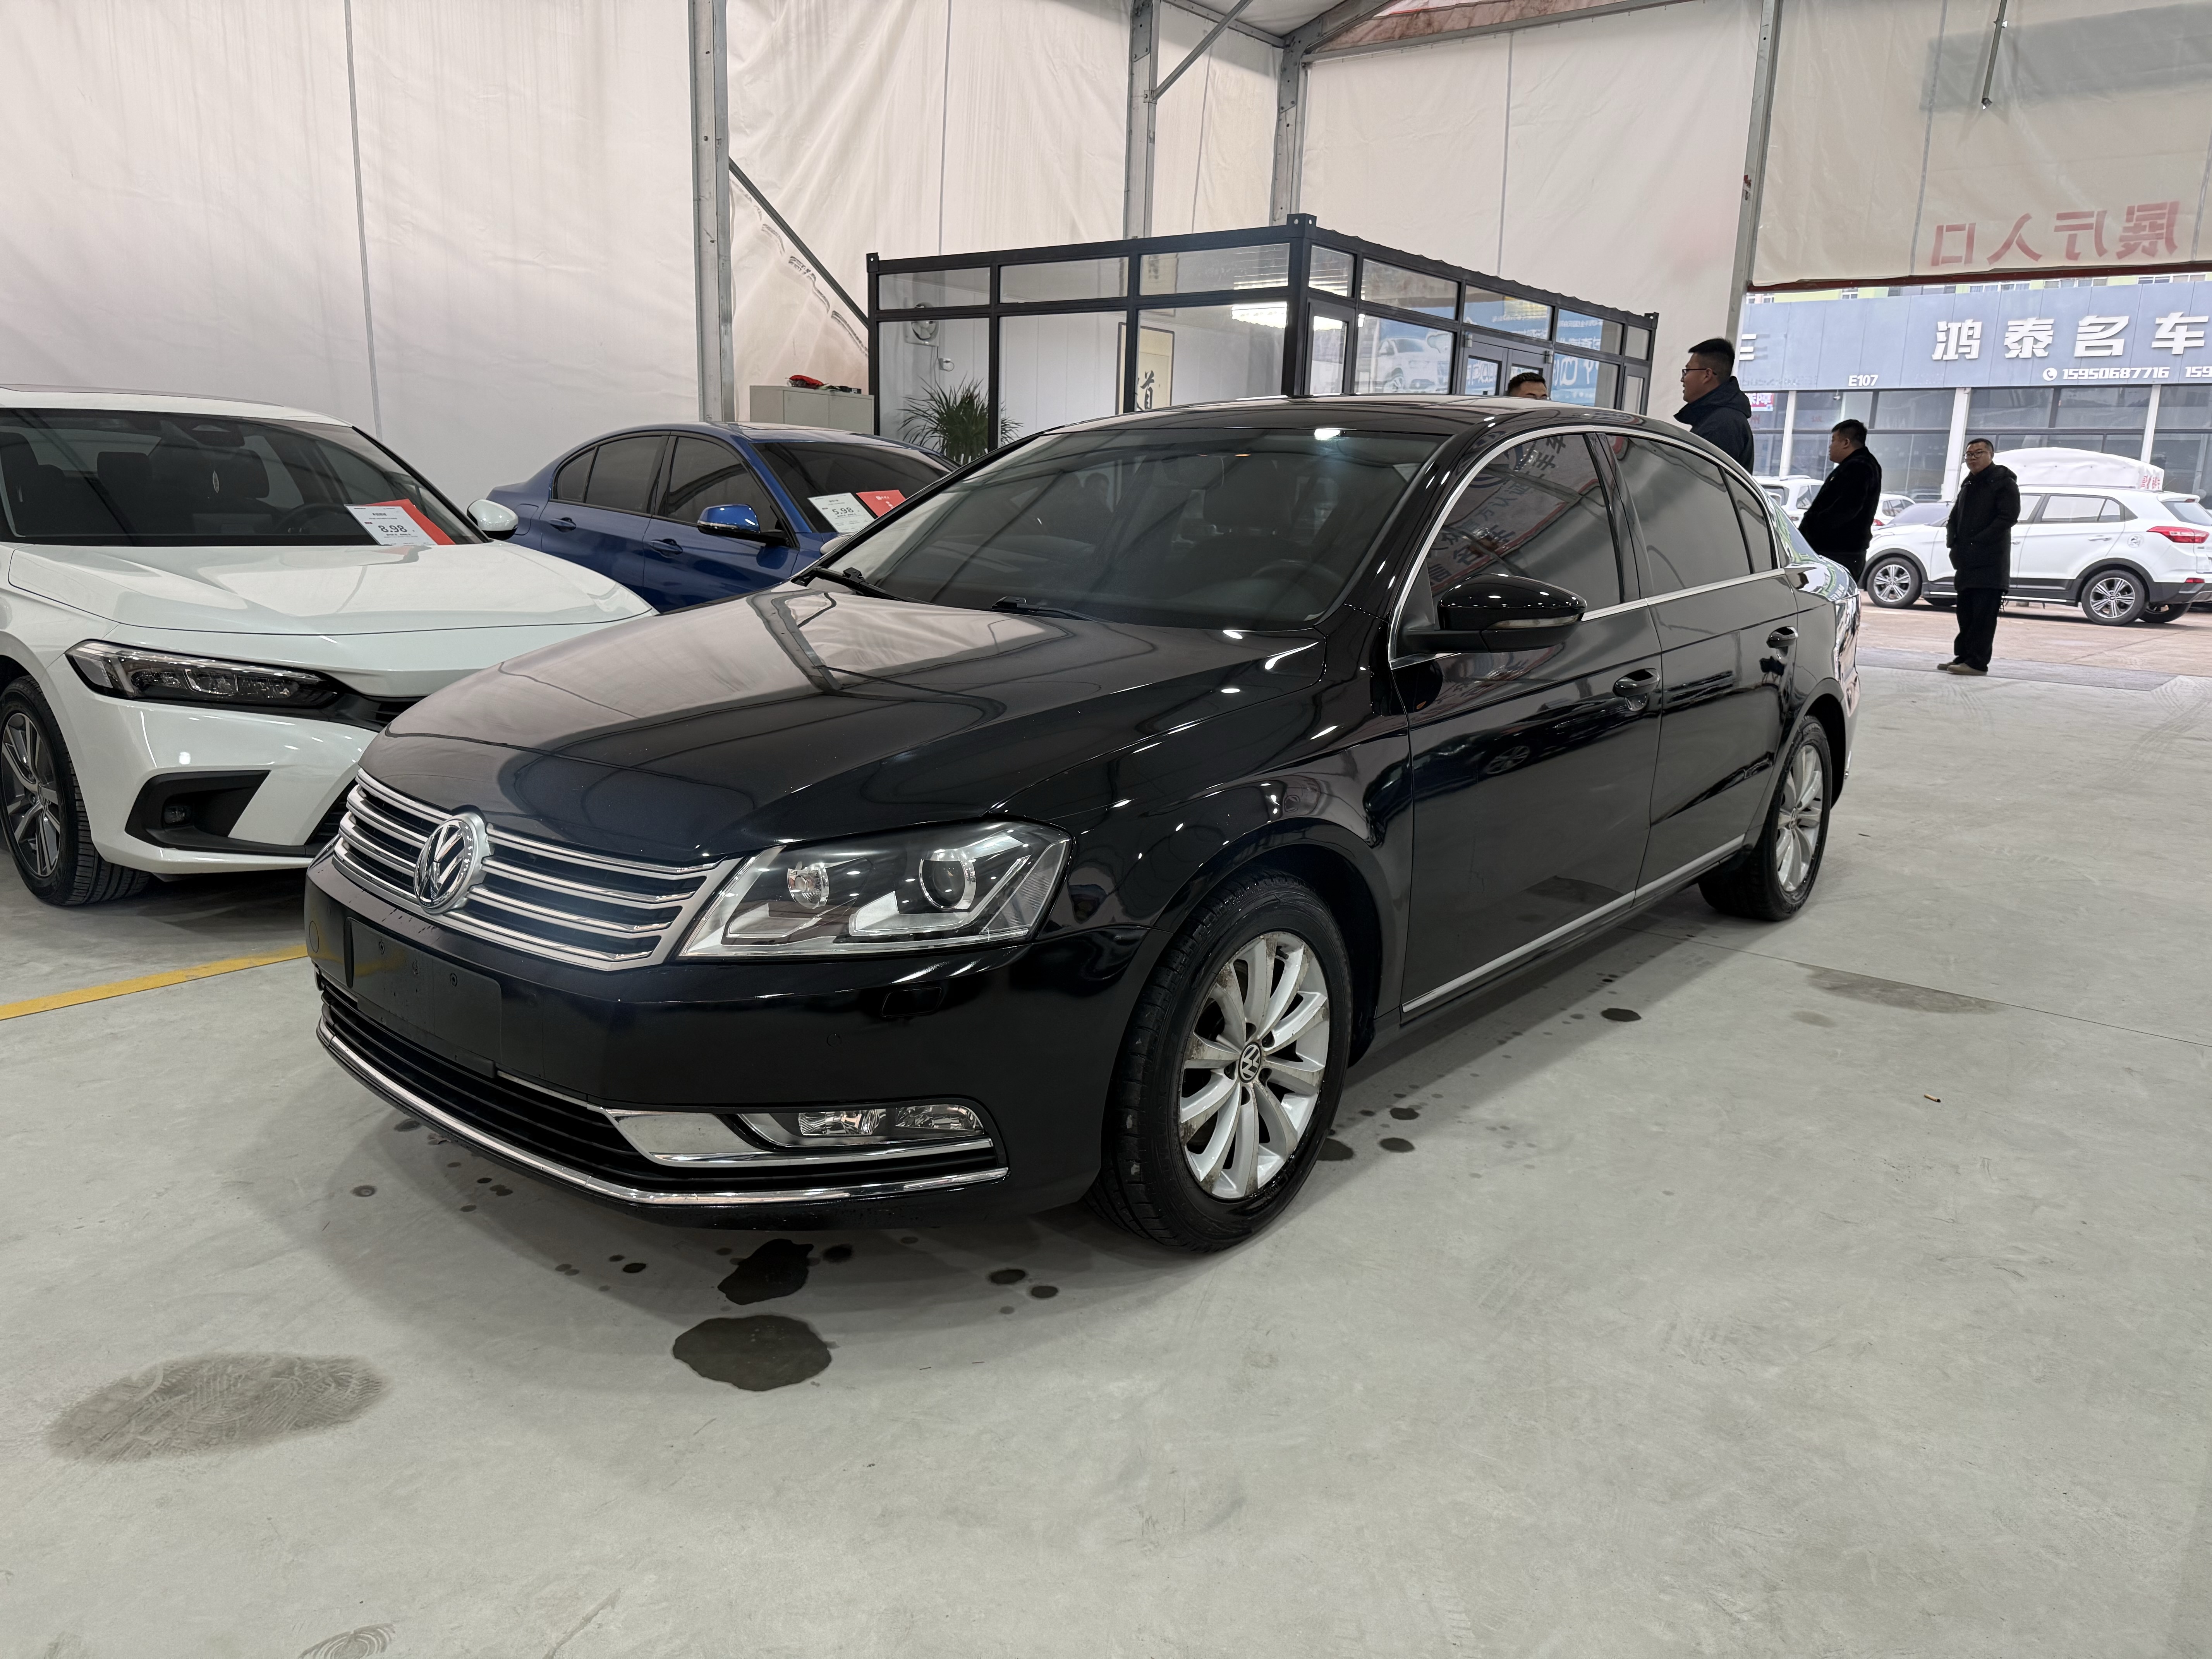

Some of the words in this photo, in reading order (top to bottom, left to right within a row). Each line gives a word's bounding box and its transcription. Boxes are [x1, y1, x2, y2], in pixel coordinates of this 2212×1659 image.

[1932, 312, 2209, 361] 鸿泰名车
[2062, 367, 2170, 380] 15950687716
[1848, 374, 1879, 387] E107
